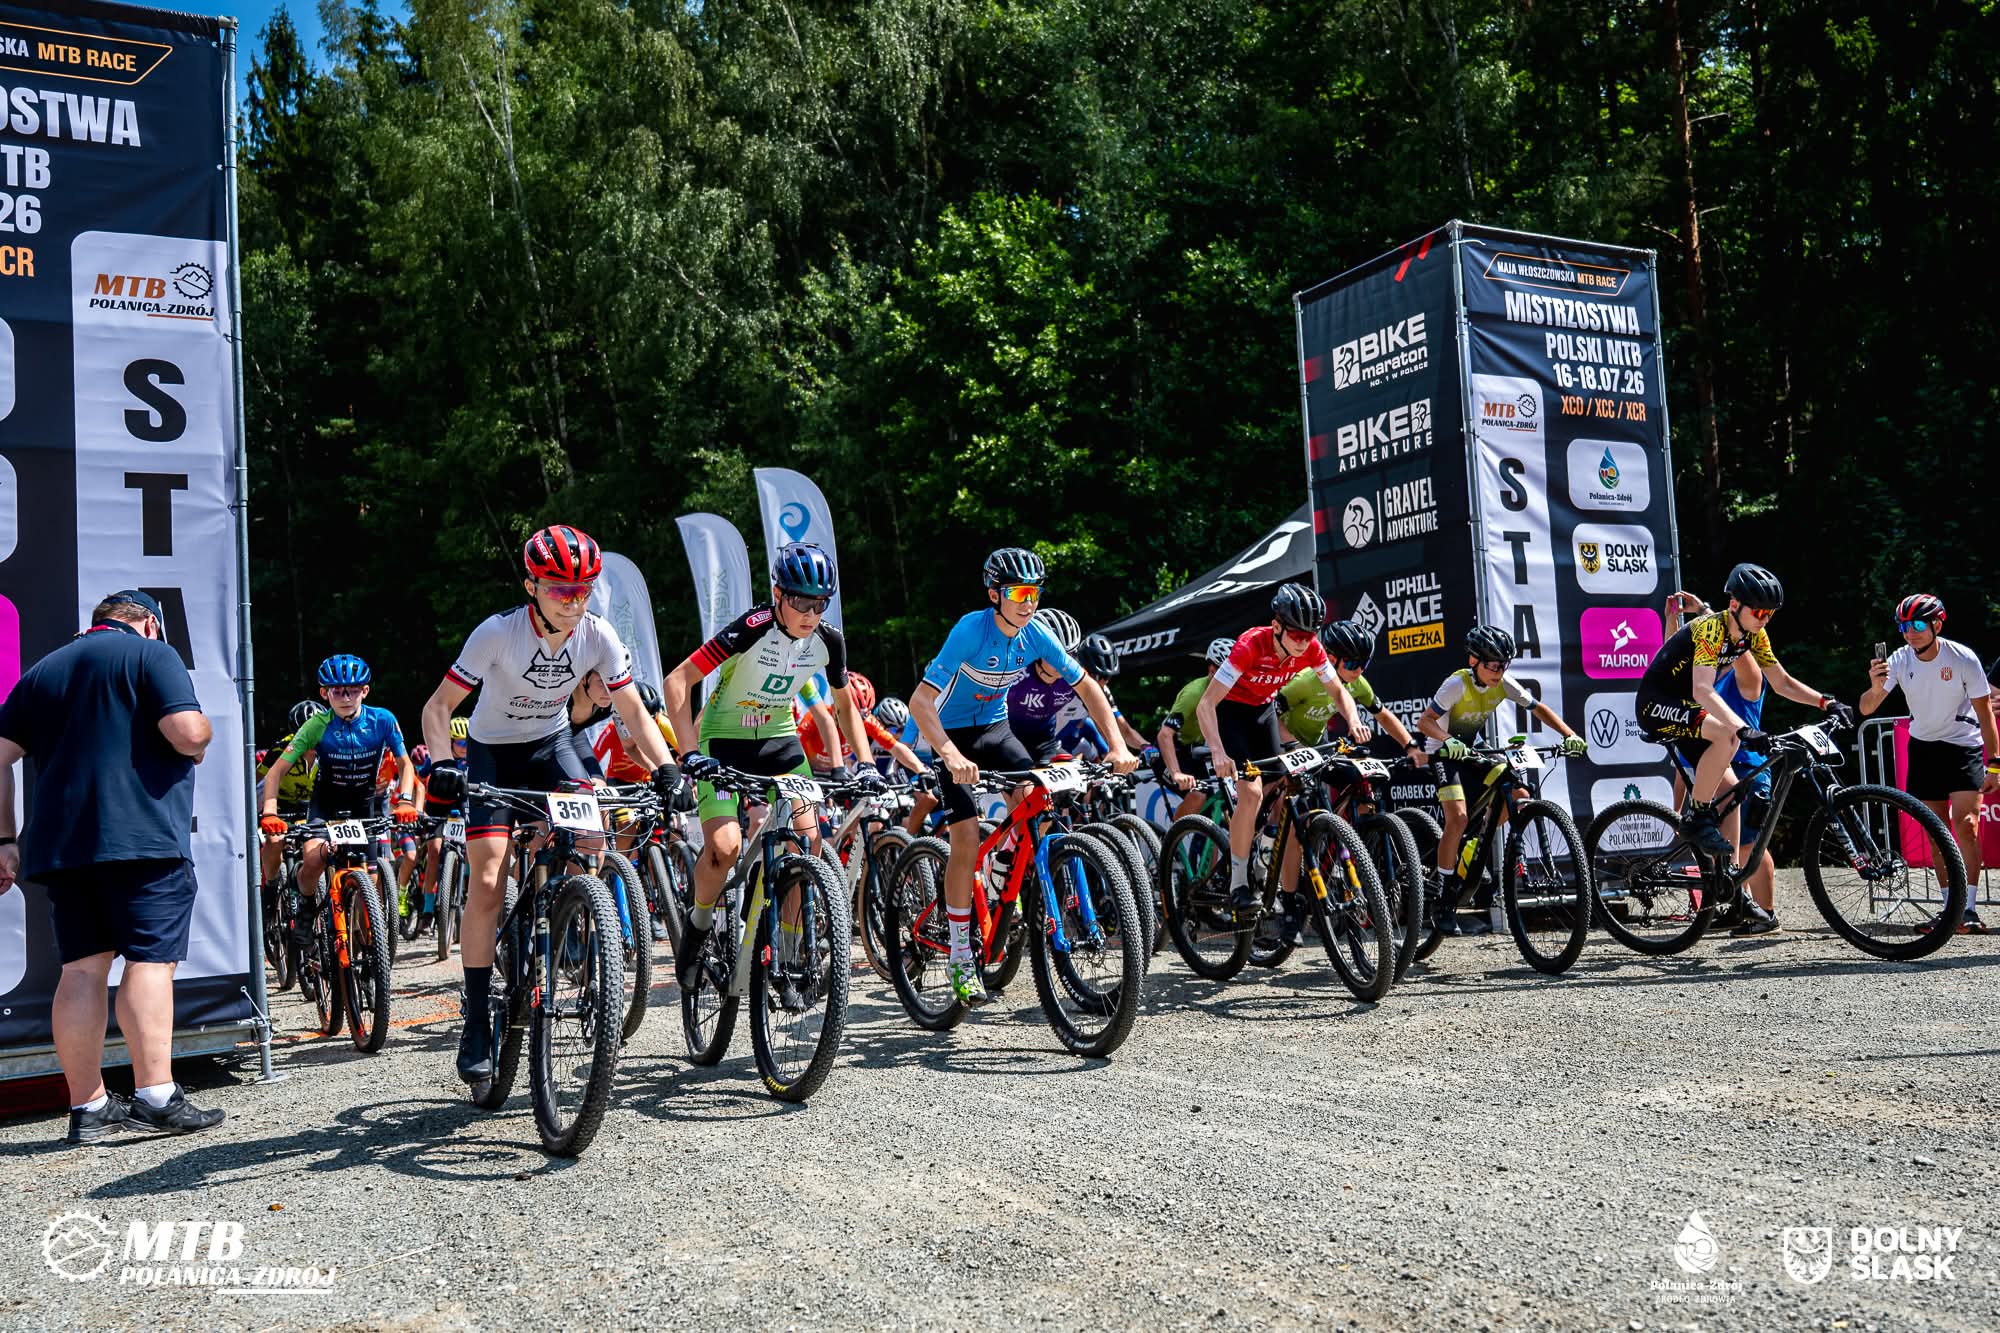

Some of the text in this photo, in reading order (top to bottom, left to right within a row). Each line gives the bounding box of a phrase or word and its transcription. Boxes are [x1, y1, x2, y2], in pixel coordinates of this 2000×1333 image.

[38, 41, 81, 65] MTB
[87, 49, 137, 72] RACE
[94, 273, 166, 299] MTB
[1496, 261, 1617, 288] MAJA WŁOSZCZOWSKA MTB RACE
[89, 298, 215, 317] POLANICA-ZDRÓJ
[1504, 290, 1641, 336] MISTRZOSTWA
[1359, 312, 1427, 363] BIKE
[1545, 332, 1642, 367] POLSKI MTB
[1362, 346, 1428, 381] maraton
[1370, 378, 1382, 387] NO.
[1400, 361, 1428, 376] POLSCE
[1553, 362, 1645, 395] 16-18.07.26
[1483, 402, 1516, 418] MTB
[1561, 395, 1647, 421] XCO / XCC / XCR
[1337, 405, 1410, 457] BIKE
[1481, 418, 1538, 430] POLANICA-ZDRÓJ
[1339, 431, 1432, 473] ADVENTURE
[1384, 476, 1437, 518] GRAVEL
[1589, 492, 1633, 503] Polanica-Zdrój
[1387, 510, 1438, 541] ADVENTURE
[1605, 543, 1649, 558] DOLNY
[1607, 556, 1649, 575] ŚLĄSK
[1385, 572, 1441, 599] UPHILL
[1387, 593, 1444, 628] RACE
[1391, 629, 1442, 651] ŚNIEŻKA
[1598, 653, 1648, 668] TAURON
[1651, 703, 1690, 724] DUKLA
[1287, 749, 1315, 767] 353
[1360, 761, 1385, 771] 354
[1390, 784, 1437, 800] GRABEK SP
[557, 800, 593, 820] 350
[334, 824, 361, 838] 366
[450, 823, 464, 836] 377
